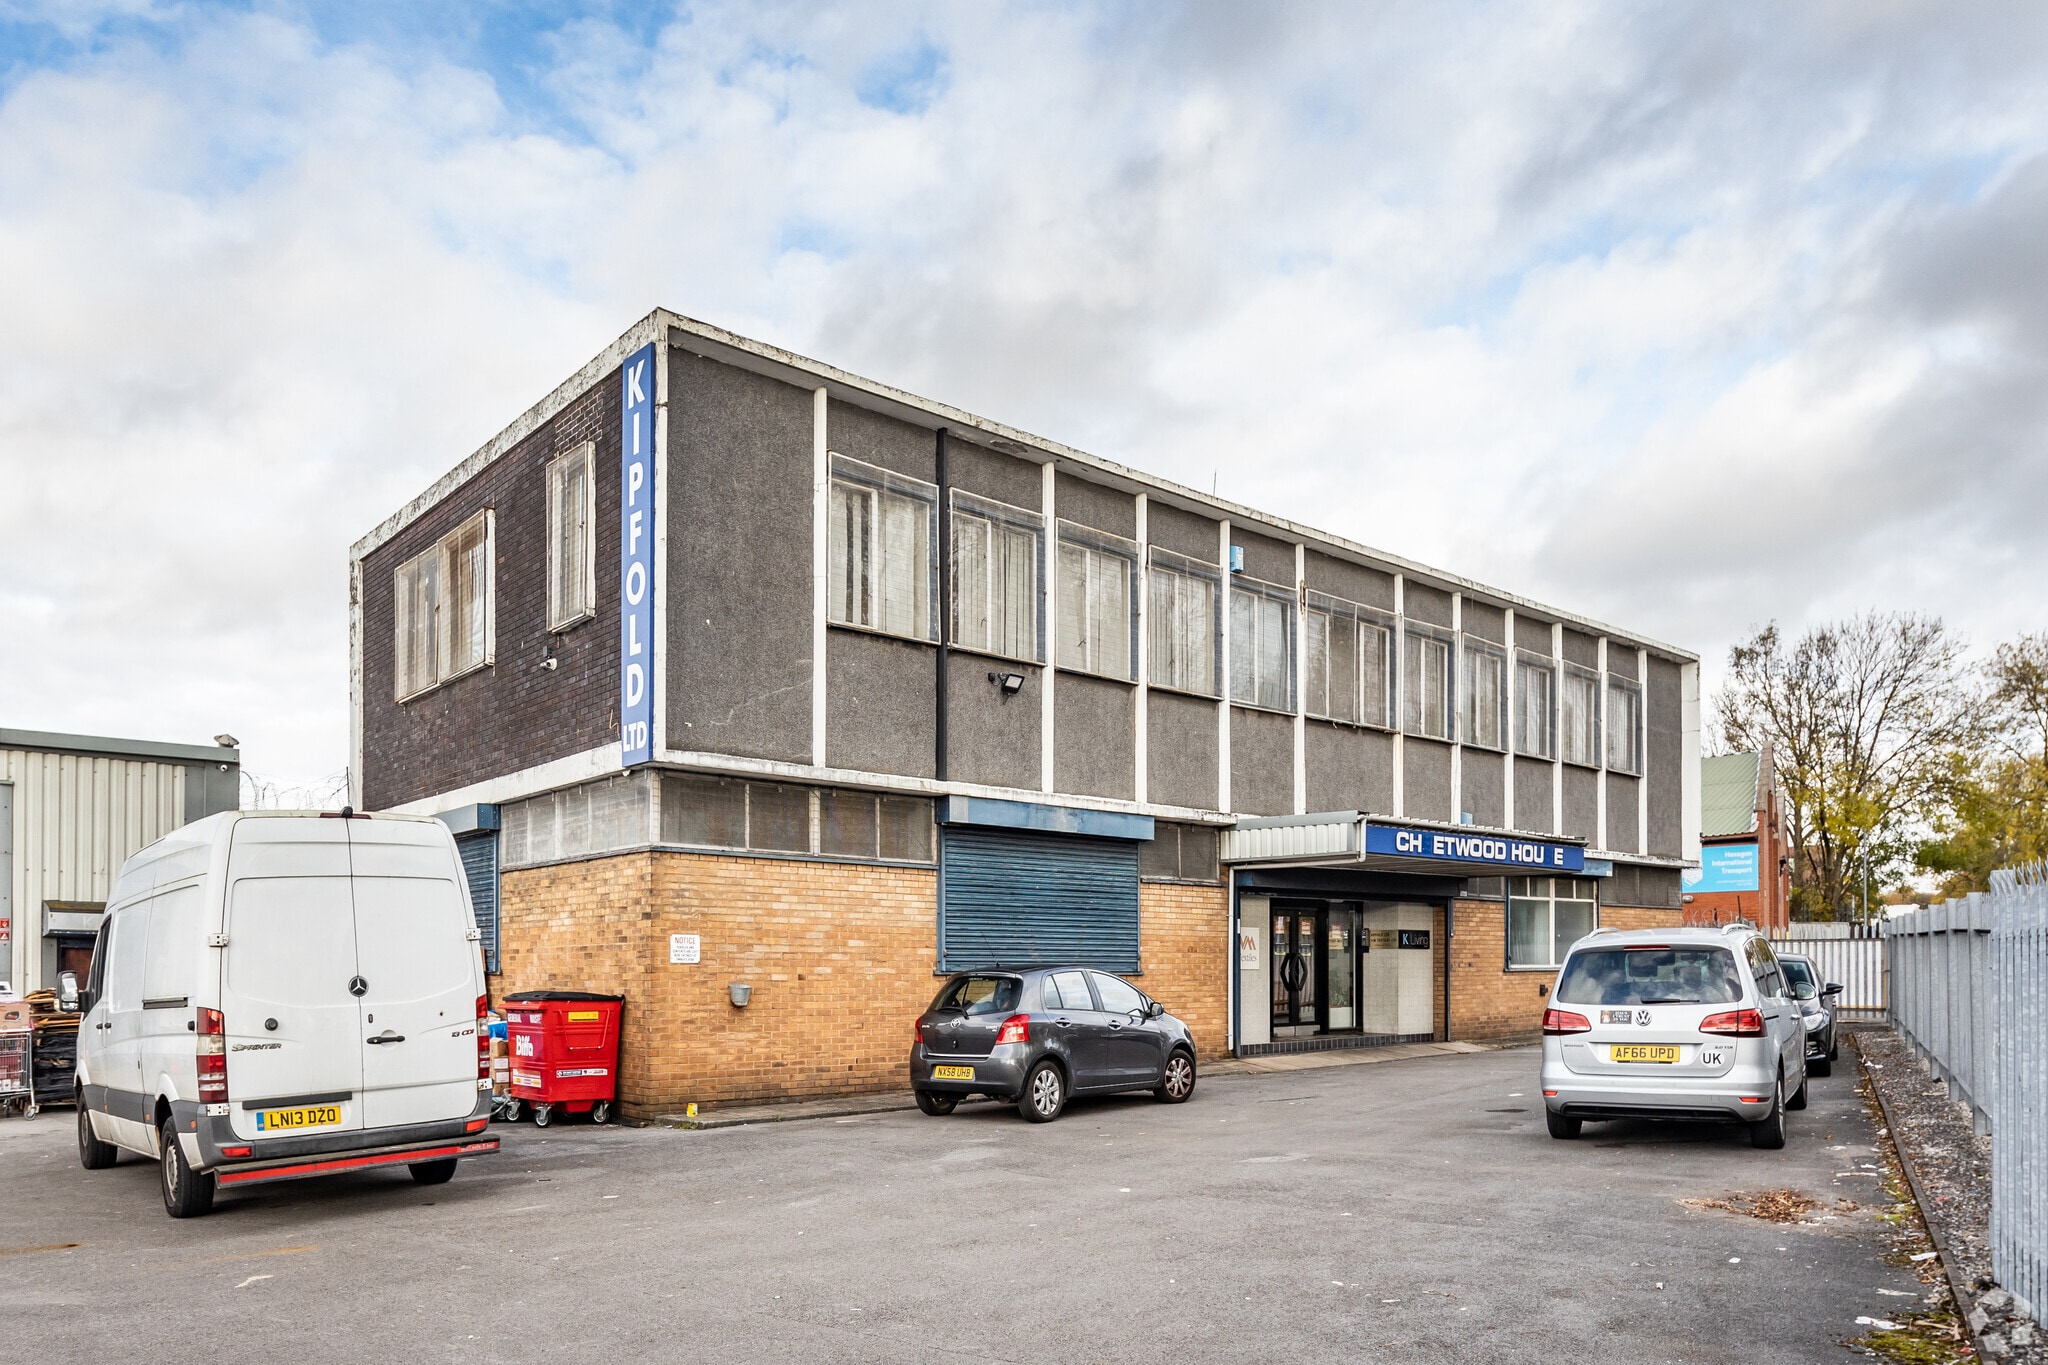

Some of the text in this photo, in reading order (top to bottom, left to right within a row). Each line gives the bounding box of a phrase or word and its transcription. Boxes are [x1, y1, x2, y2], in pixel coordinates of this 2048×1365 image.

[625, 358, 647, 708] KIPFOLD
[623, 720, 648, 753] LTD
[1396, 831, 1564, 866] CHETWOOD HOUE
[1724, 851, 1753, 859] Hexagon
[1711, 858, 1753, 866] International
[1721, 867, 1753, 875] Transport
[675, 937, 696, 945] NOTICE
[1402, 932, 1429, 948] K Living
[515, 1035, 534, 1057] Biffa
[1615, 1047, 1675, 1059] AF66 UPD
[1702, 1053, 1722, 1065] UK
[938, 1067, 971, 1078] NX58 UHB
[270, 1111, 304, 1128] LN13
